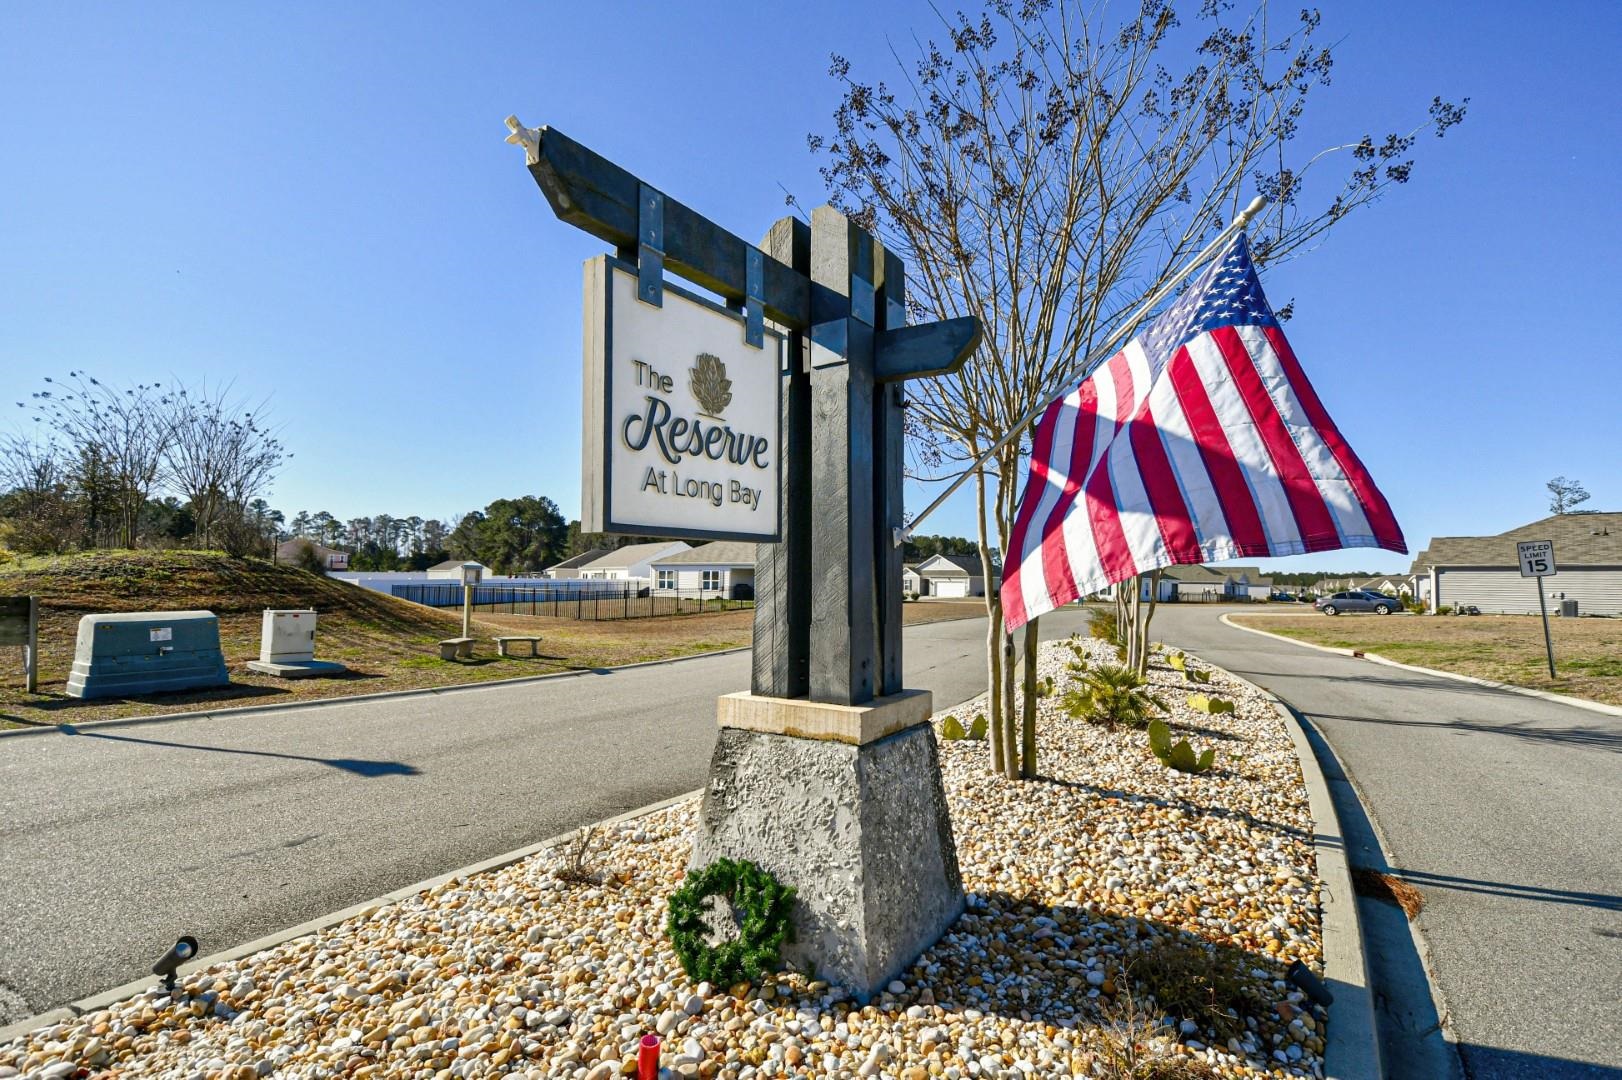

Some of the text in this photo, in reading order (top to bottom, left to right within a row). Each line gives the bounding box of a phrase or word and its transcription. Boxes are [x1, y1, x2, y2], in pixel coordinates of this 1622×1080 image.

[632, 359, 674, 394] The
[623, 396, 770, 470] Reserve
[641, 466, 762, 511] At Long Bay
[1520, 544, 1550, 552] SPEED
[1524, 551, 1547, 559] LIMIT
[1527, 559, 1548, 573] 15
